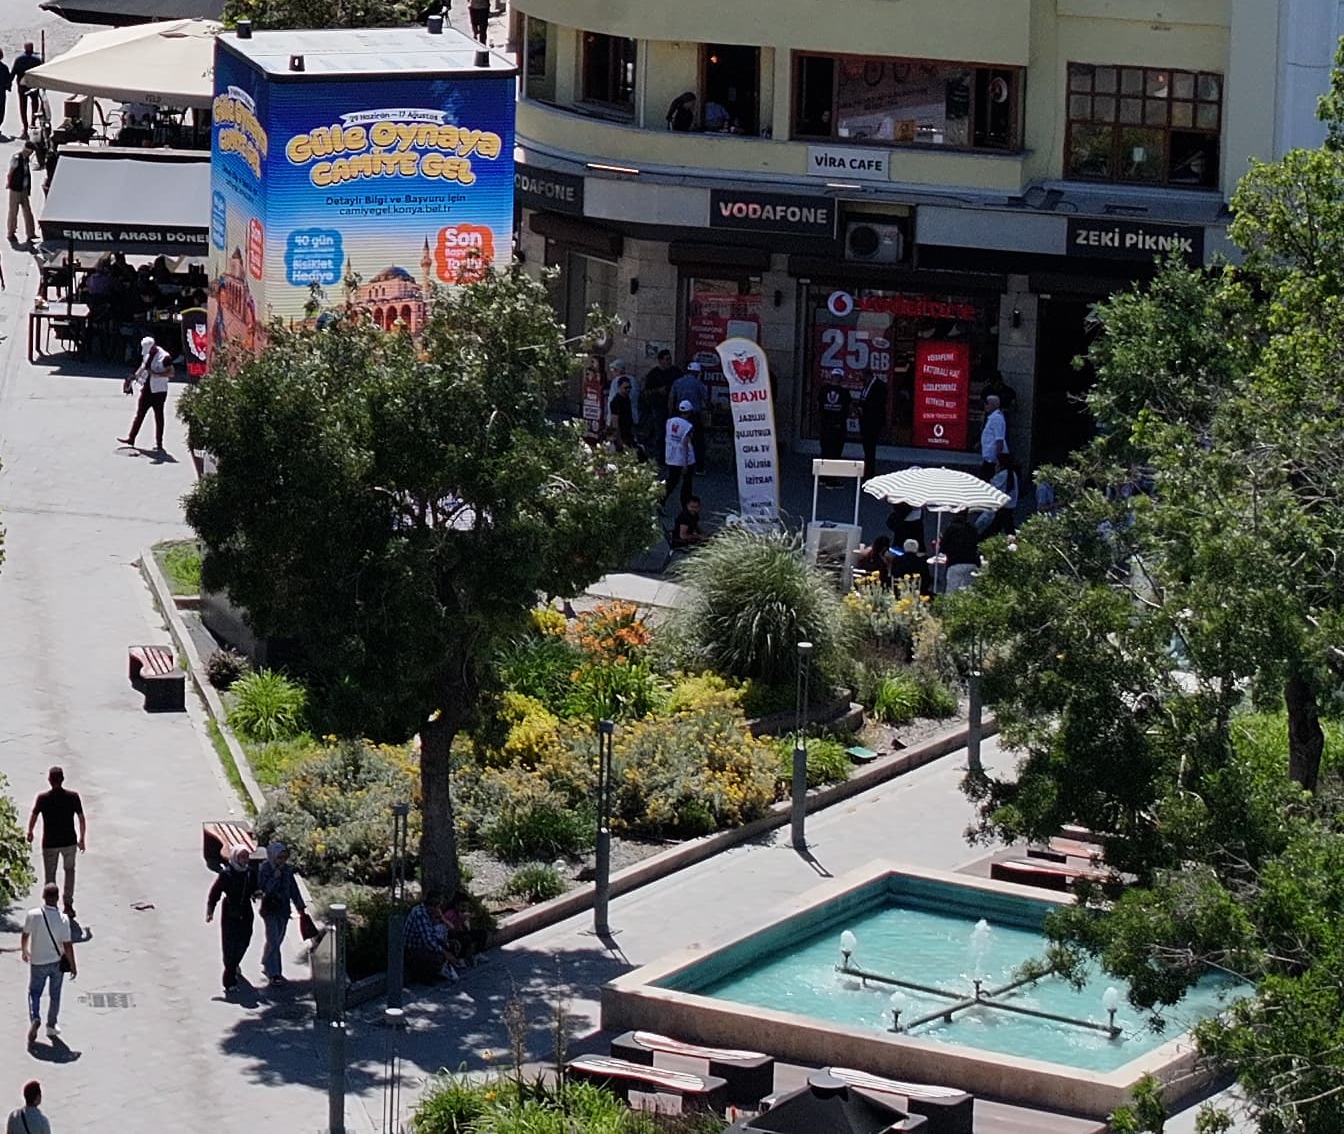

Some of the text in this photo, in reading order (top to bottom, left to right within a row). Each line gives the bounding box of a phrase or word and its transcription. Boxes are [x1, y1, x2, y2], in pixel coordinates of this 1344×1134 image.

[287, 124, 367, 163] Güle
[369, 121, 501, 160] Oynaya
[421, 153, 476, 185] GEL
[815, 153, 883, 171] VİRA CAFE
[365, 195, 387, 206] Bilgi
[405, 195, 445, 205] Başvuru
[720, 201, 827, 224] VODAFONE
[64, 230, 113, 241] EKMEK
[120, 232, 162, 241] ARASI
[445, 229, 482, 246] Son
[1076, 228, 1193, 253] ZEKİ PİKNİK
[820, 329, 890, 371] 25 GB
